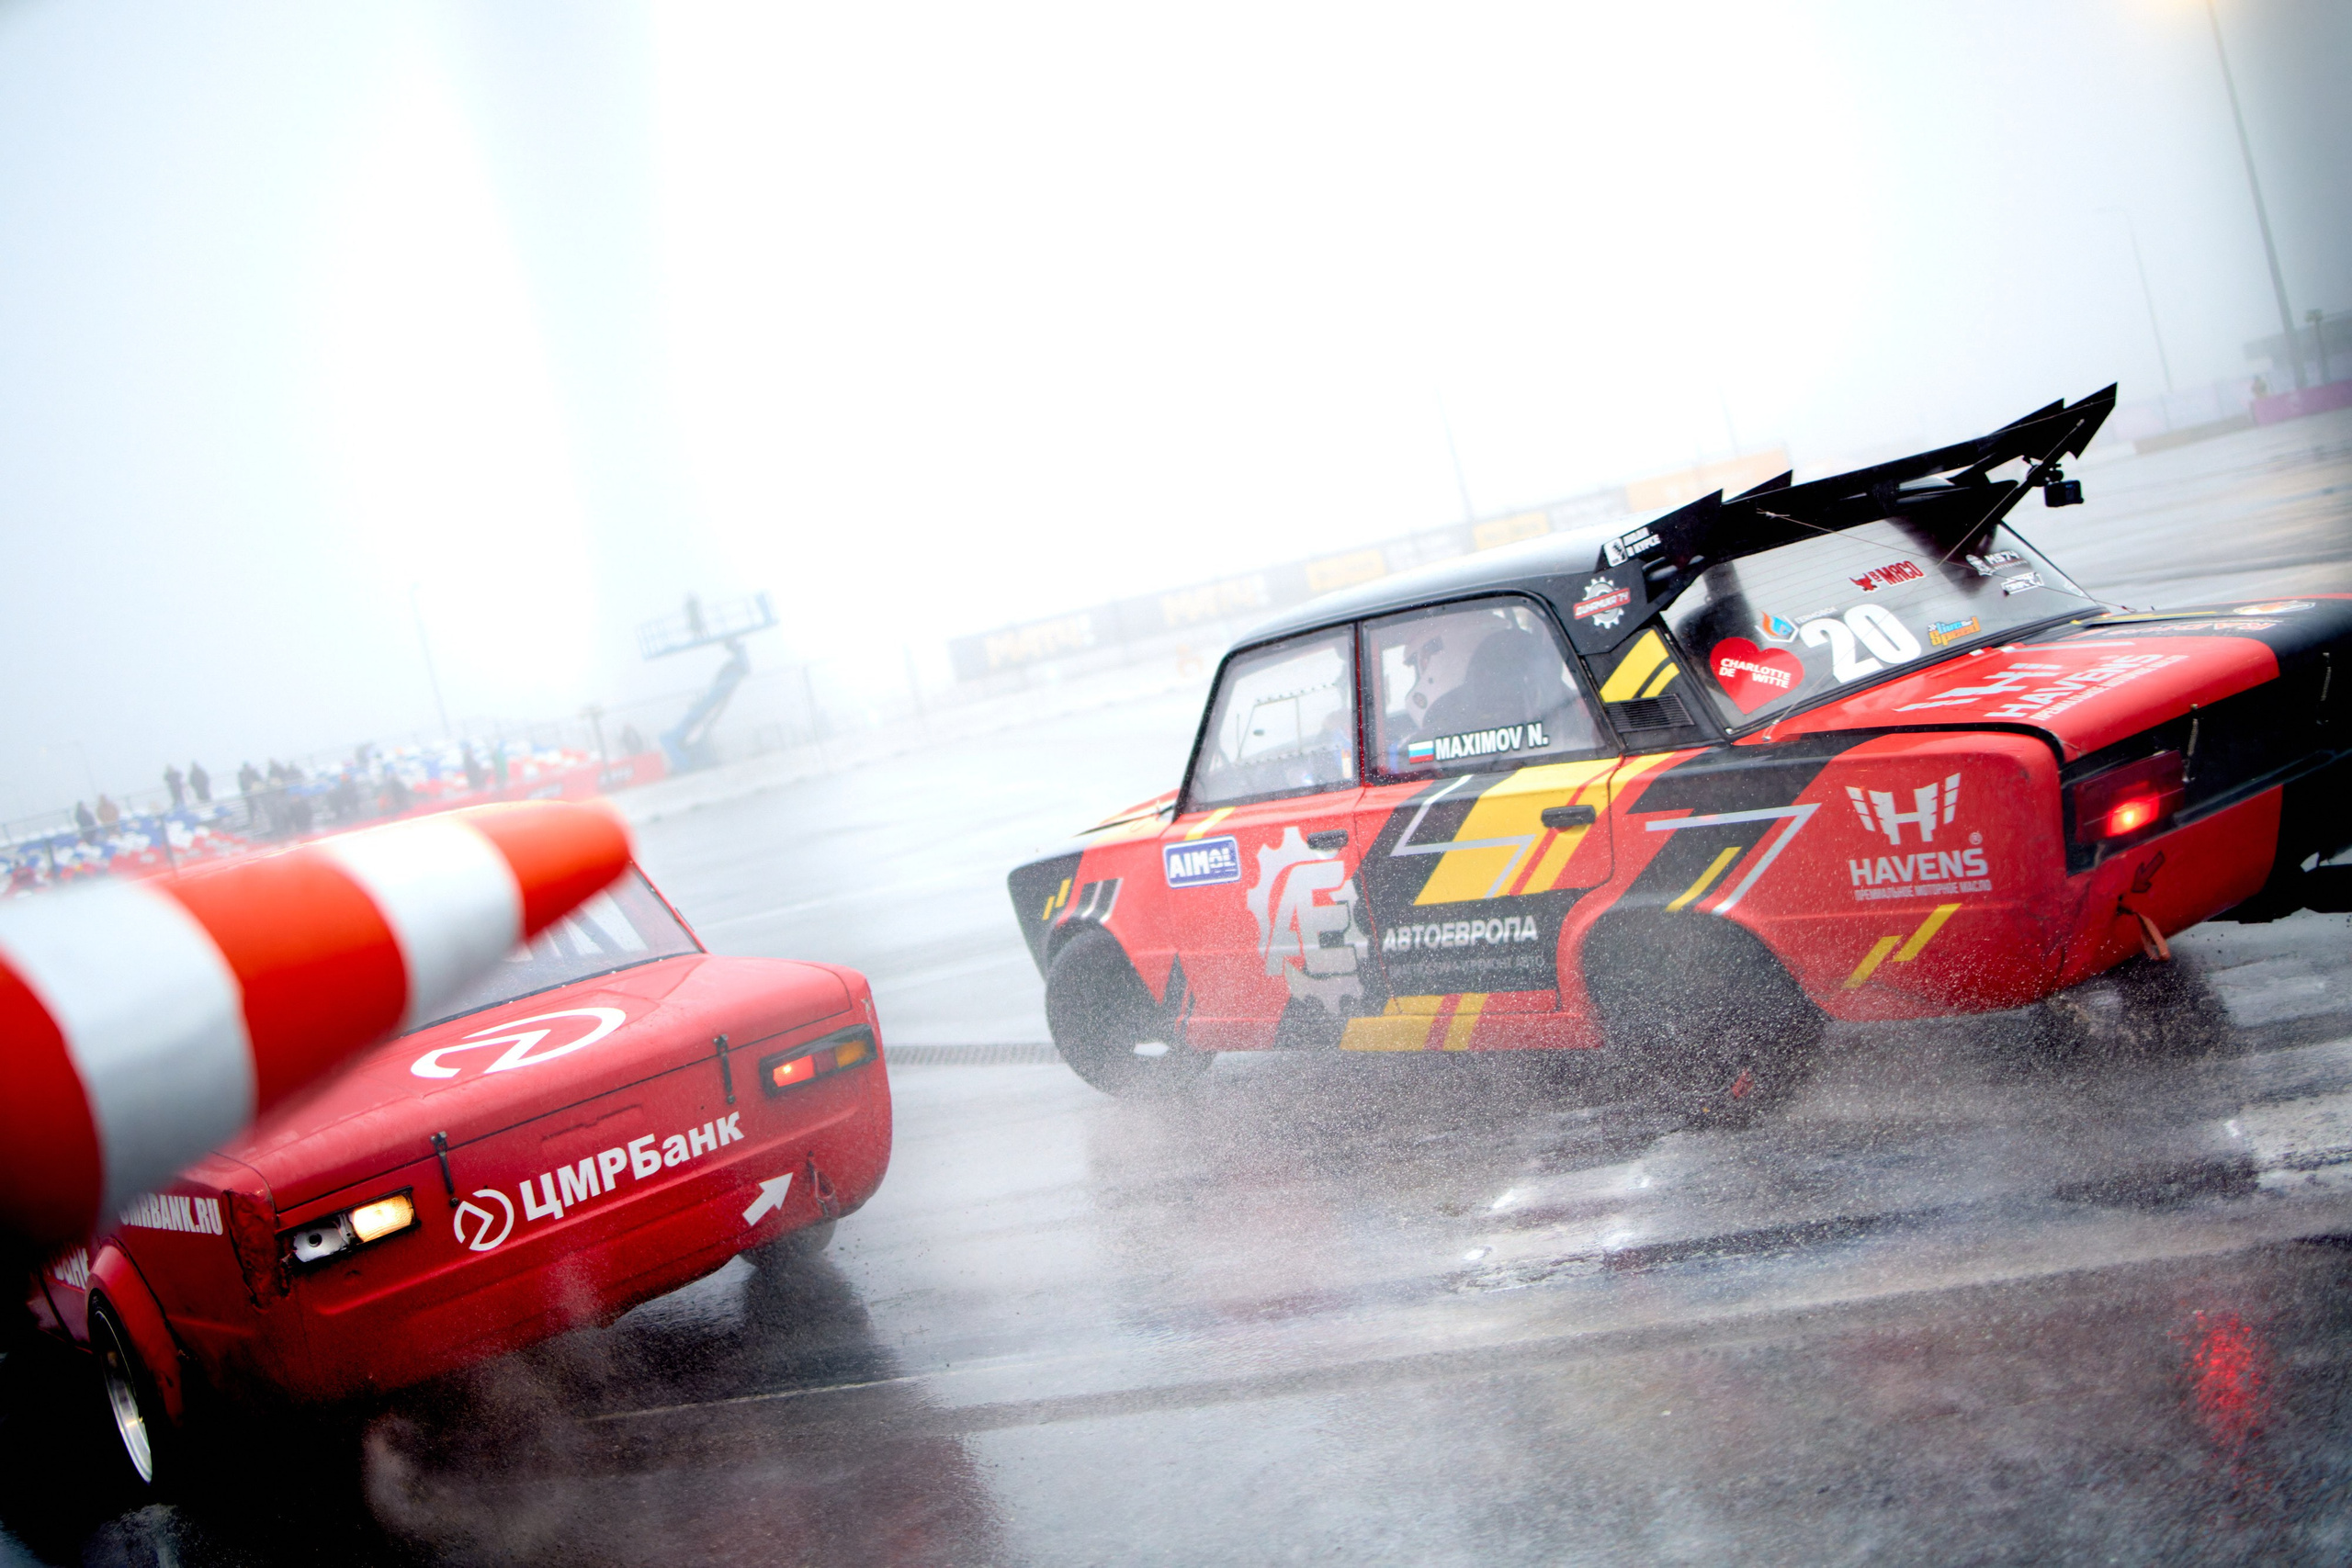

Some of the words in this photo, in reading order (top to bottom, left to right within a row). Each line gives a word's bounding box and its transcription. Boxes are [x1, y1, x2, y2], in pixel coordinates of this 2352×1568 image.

[1875, 560, 1925, 585] МЯСО
[1984, 550, 2019, 565] MS74
[1799, 604, 1921, 683] 20
[1719, 667, 1736, 677] DE
[1752, 672, 1790, 688] WITTE
[1720, 658, 1792, 680] CHARLOTTE
[1983, 653, 2164, 717] HAVENS
[1435, 726, 1523, 761] MAXIMOV
[1527, 722, 1549, 747] N.
[1170, 847, 1237, 878] AIMOL
[1849, 848, 1988, 886] HAVENS
[1382, 915, 1538, 953] АВТОЕВРОПА
[519, 1111, 744, 1222] ЦМРБанк
